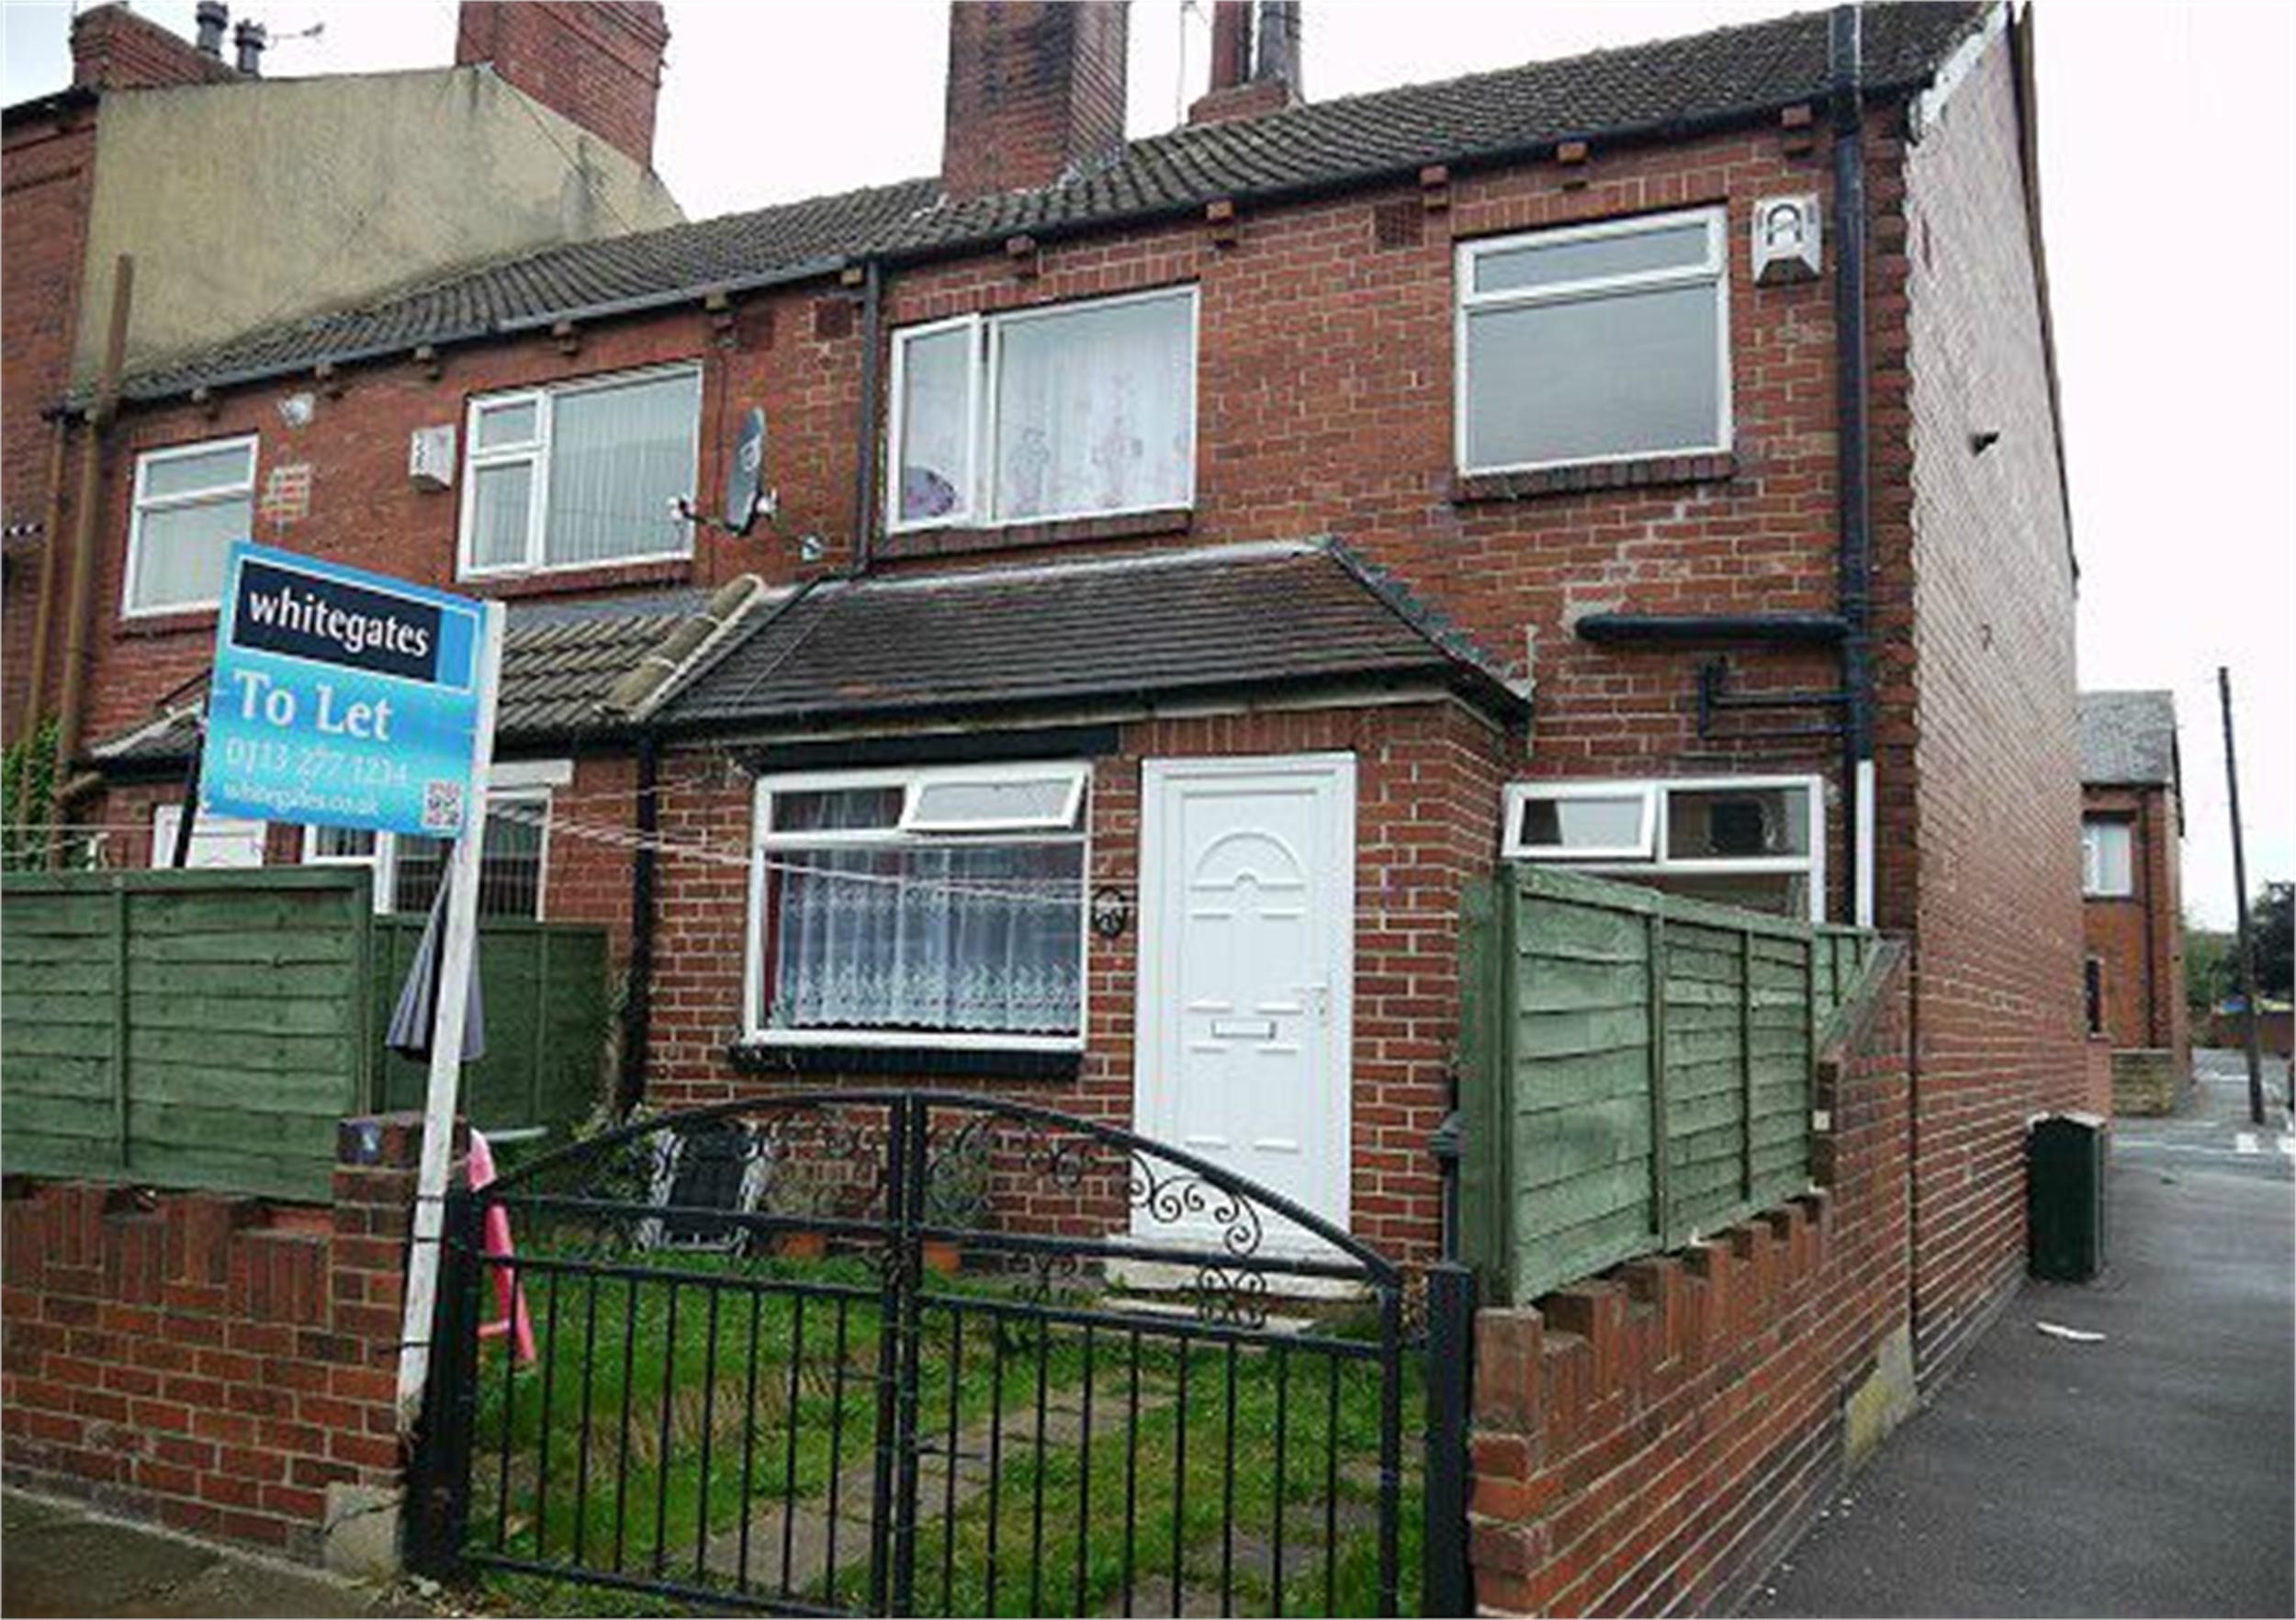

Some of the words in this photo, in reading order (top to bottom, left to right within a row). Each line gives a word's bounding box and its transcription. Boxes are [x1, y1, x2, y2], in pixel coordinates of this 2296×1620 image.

[249, 587, 431, 658] whitegates
[234, 669, 297, 726] To
[316, 683, 394, 742] Let
